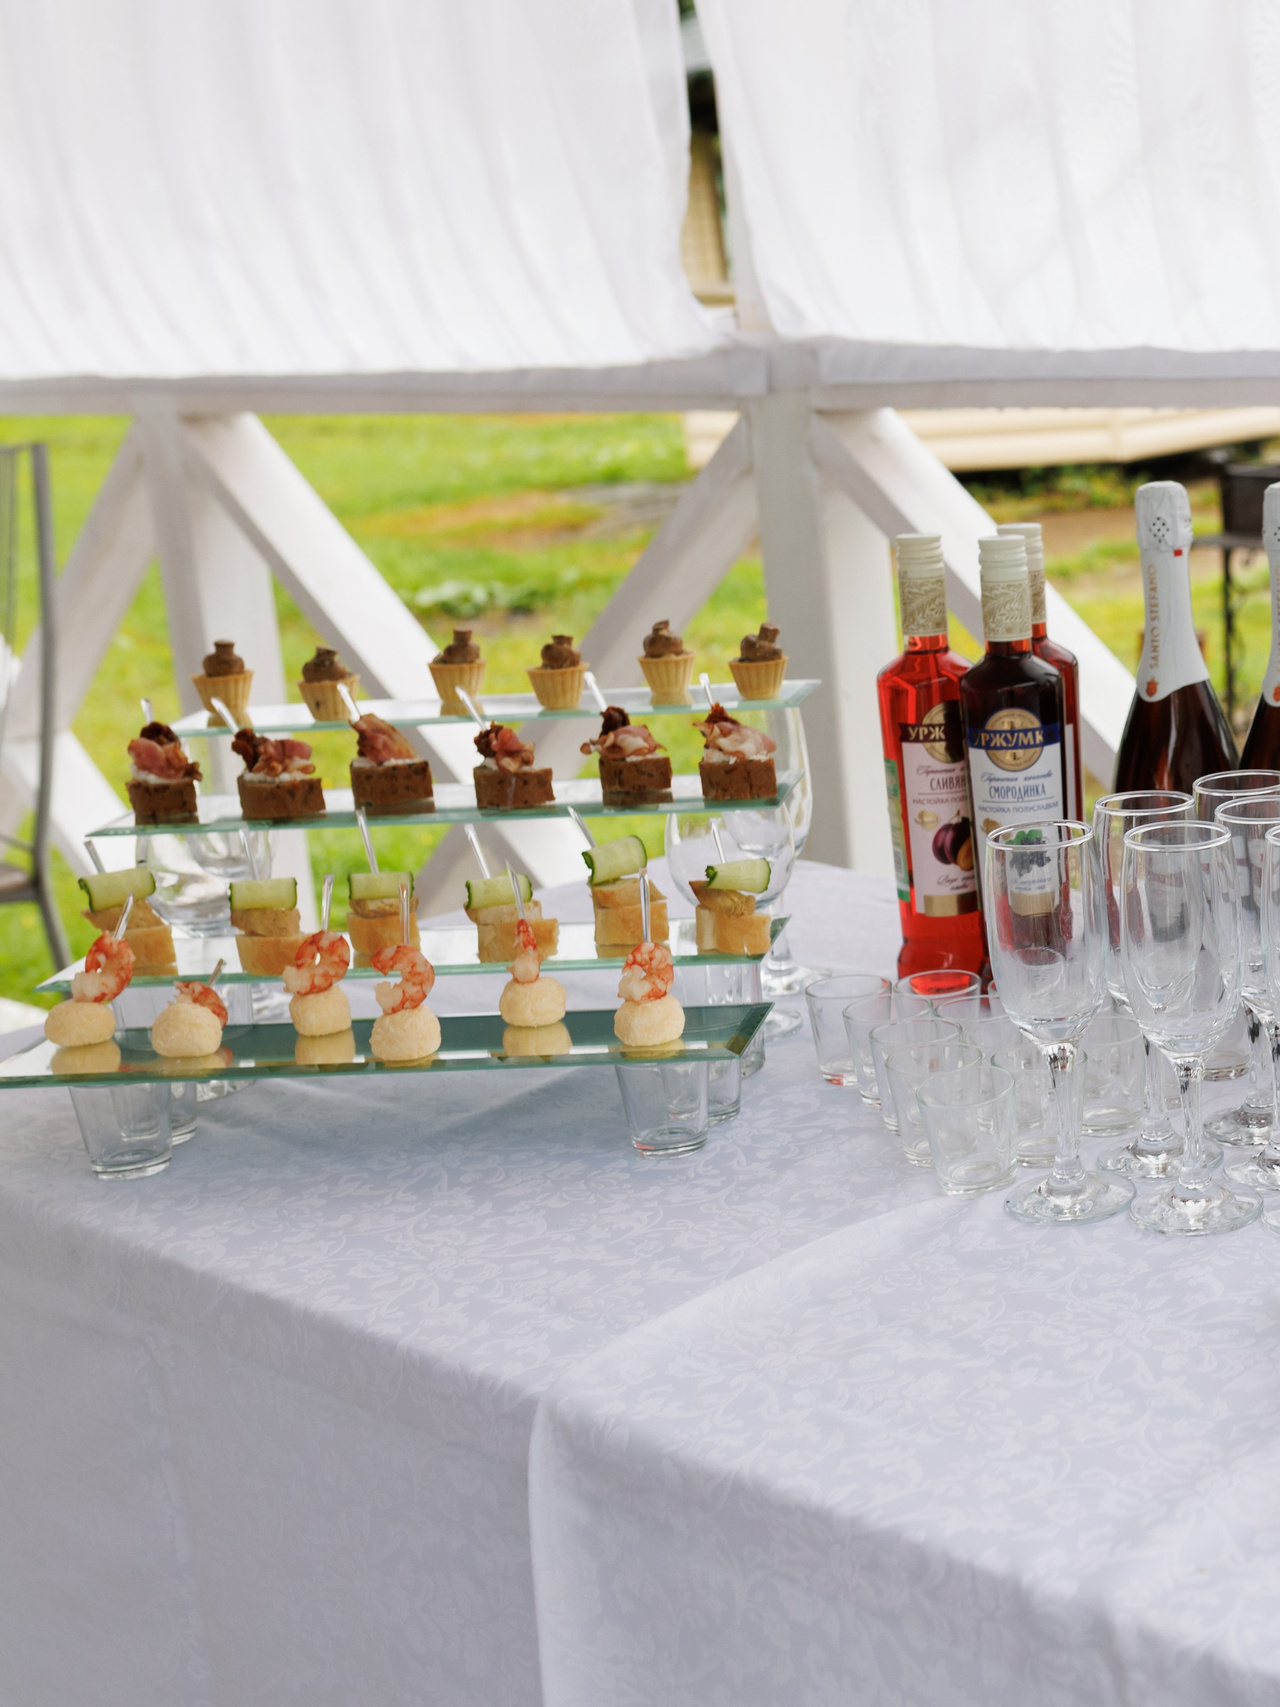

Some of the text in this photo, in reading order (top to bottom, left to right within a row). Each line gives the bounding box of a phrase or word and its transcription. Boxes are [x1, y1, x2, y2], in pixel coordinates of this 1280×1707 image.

[1147, 564, 1160, 669] SANTO STEFANO
[908, 725, 946, 741] УРЖ
[930, 777, 967, 791] СЛИВЯН
[988, 783, 1047, 802] СМОРОДИНКА
